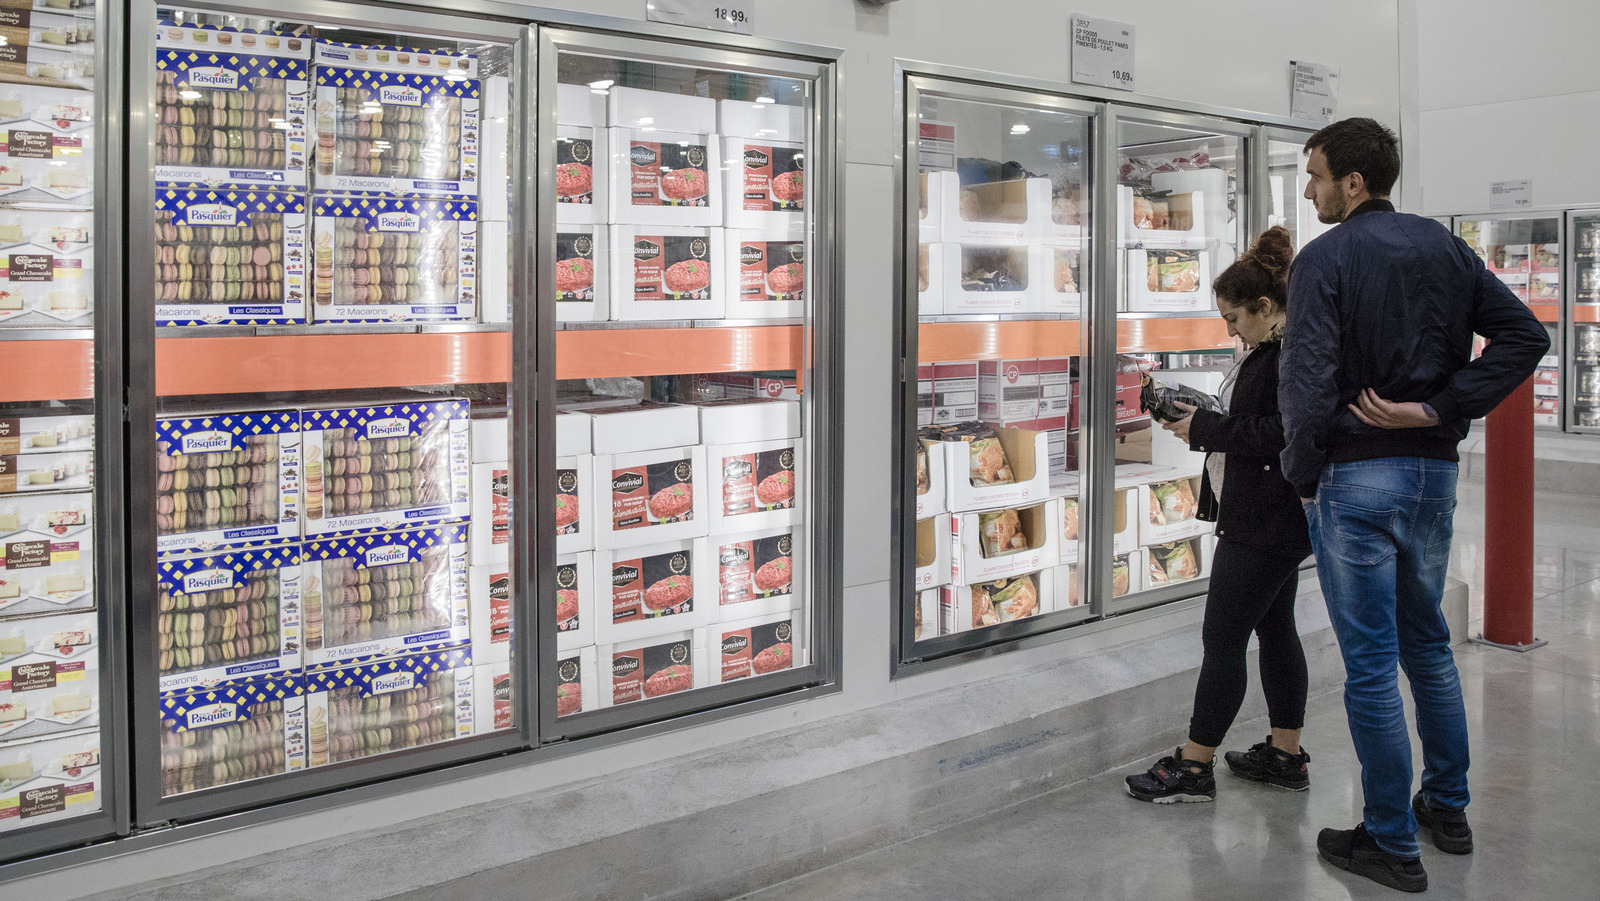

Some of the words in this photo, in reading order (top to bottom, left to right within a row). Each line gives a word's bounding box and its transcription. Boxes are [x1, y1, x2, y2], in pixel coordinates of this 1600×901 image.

[193, 72, 234, 84] Pasquier
[383, 90, 419, 104] Pasquier
[349, 179, 390, 188] Macarons
[191, 209, 232, 221] Pasquier
[382, 217, 416, 228] Pasquier
[347, 308, 387, 316] Macarons
[1008, 371, 1017, 379] CP
[768, 383, 781, 392] CP
[1117, 409, 1136, 418] BREASTS
[370, 423, 406, 436] Pasquier
[186, 438, 228, 449] Pasquier
[612, 477, 642, 488] Convivial
[613, 500, 621, 508] 18
[339, 516, 381, 527] Macarons
[240, 528, 275, 537] Classiques
[21, 549, 44, 557] Factory
[369, 551, 406, 563] Pasquier
[188, 575, 230, 588] Pasquier
[326, 650, 337, 658] 72
[338, 643, 380, 656] Macarons
[418, 632, 449, 642] Classiques
[242, 661, 277, 672] Classiques
[612, 660, 638, 671] onvivial
[27, 671, 50, 679] Factory
[375, 678, 411, 691] Pasquier
[191, 710, 233, 724] Pasquier
[35, 795, 58, 804] Factory
